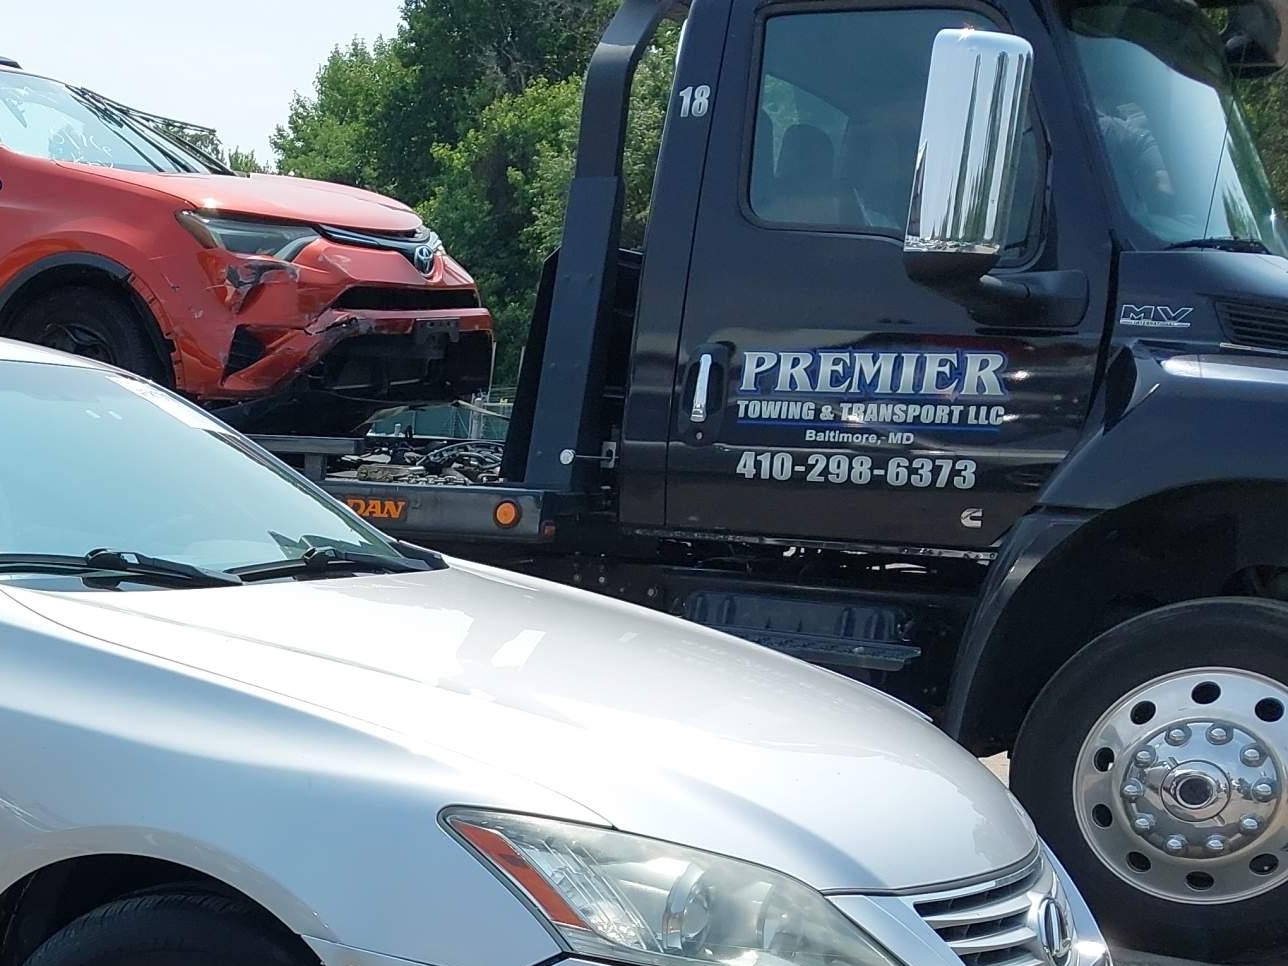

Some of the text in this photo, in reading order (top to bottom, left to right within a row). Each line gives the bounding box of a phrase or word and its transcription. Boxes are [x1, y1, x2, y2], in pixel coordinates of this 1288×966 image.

[679, 85, 711, 118] 18
[1120, 304, 1194, 321] MV
[739, 351, 1005, 396] PREMIER
[736, 400, 1006, 426] TOWING & TRANSPORT LLC
[888, 432, 915, 445] MD
[735, 451, 977, 489] 410-298-6373
